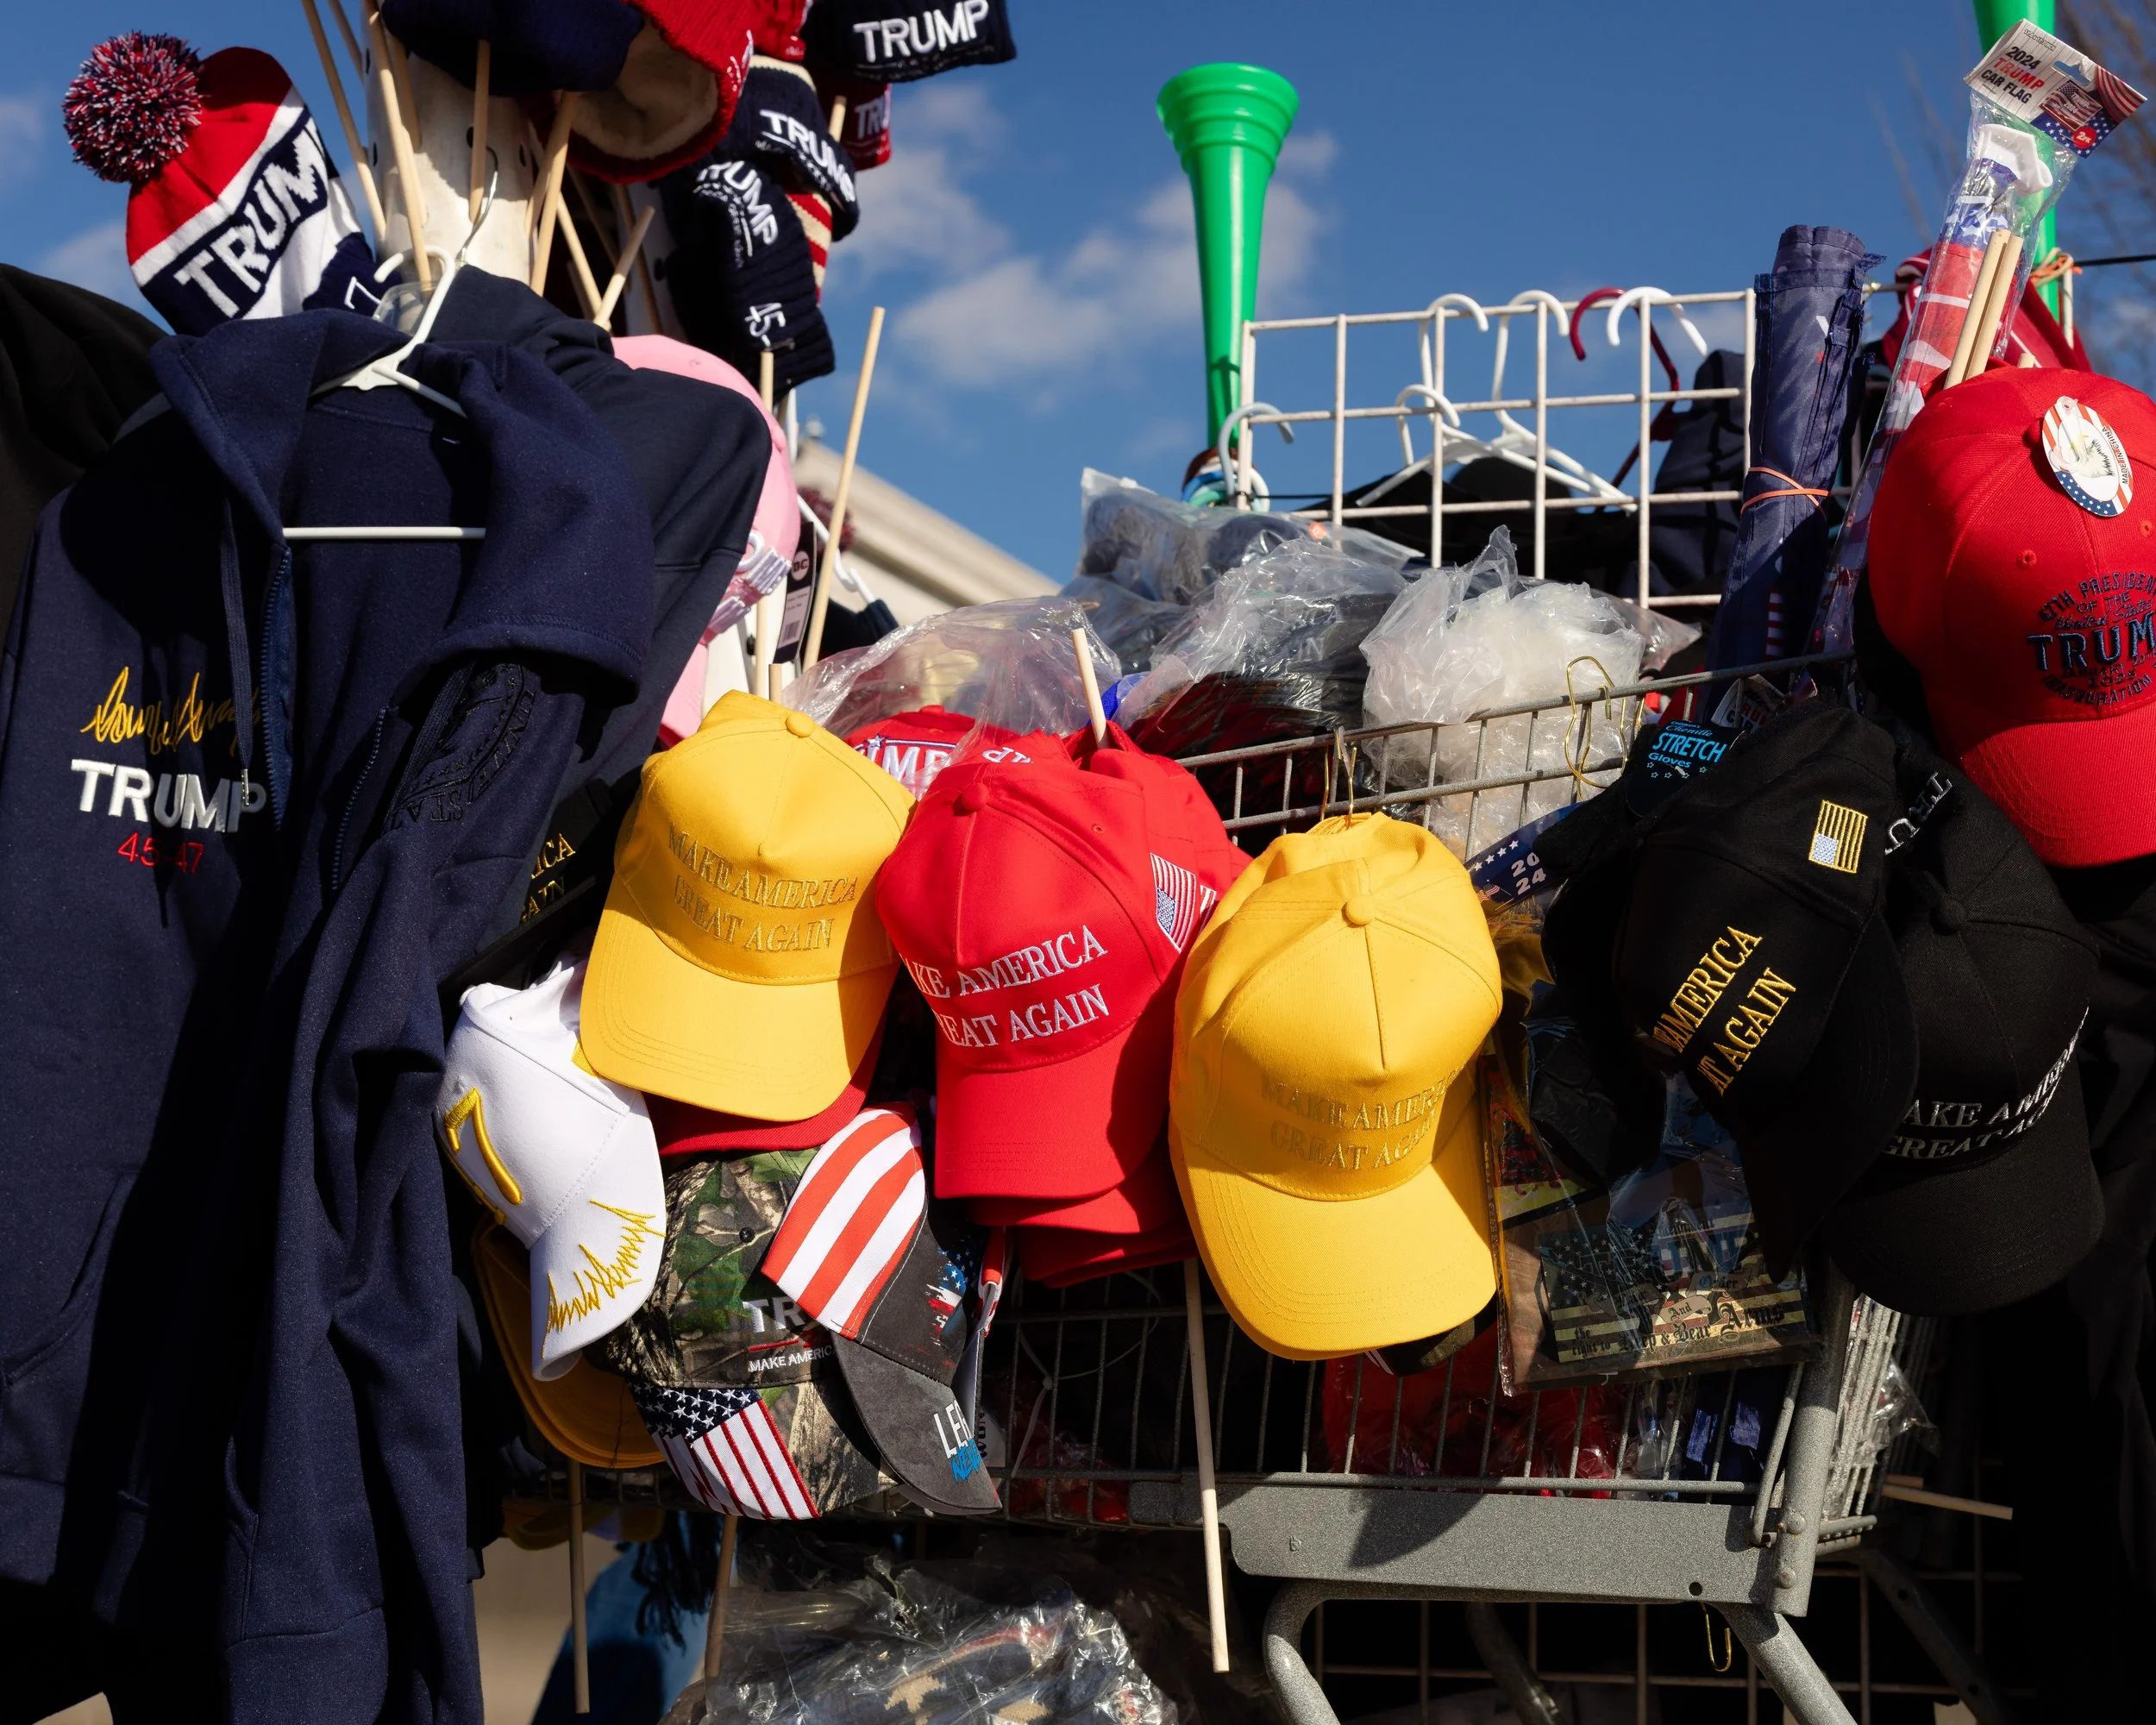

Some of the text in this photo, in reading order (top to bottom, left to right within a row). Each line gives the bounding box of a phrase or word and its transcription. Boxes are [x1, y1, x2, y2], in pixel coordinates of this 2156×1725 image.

[853, 0, 988, 62] TRUMP
[1993, 57, 2046, 91] TRUMP
[2005, 46, 2041, 70] 2024
[1981, 69, 2005, 87] CAR
[2003, 80, 2033, 104] FLAG
[174, 119, 325, 317] TRUM
[2103, 426, 2119, 449] CHINA
[2078, 591, 2131, 615] OF THE
[2028, 611, 2156, 670] TRUM
[1648, 752, 1692, 768] Gloves
[1652, 732, 1727, 762] STRETCH
[71, 759, 266, 833] TRUMP
[118, 832, 204, 873] 45-47
[669, 823, 858, 909] MAKE AMERICA
[1515, 868, 1546, 895] 24
[674, 875, 835, 952] GREAT AGAIN
[957, 925, 1108, 997] AMERICA
[1010, 984, 1109, 1043] AGAIN
[1713, 967, 1796, 1071] AGAIN
[1261, 1076, 1349, 1126] MAKE
[1903, 1098, 1984, 1128] AKE
[1270, 1121, 1369, 1170] GREAT
[1661, 1331, 1670, 1346] &
[1673, 1320, 1711, 1349] Bear
[1720, 1301, 1785, 1342] Arms
[1668, 1304, 1692, 1320] And
[748, 1356, 787, 1373] MAKE
